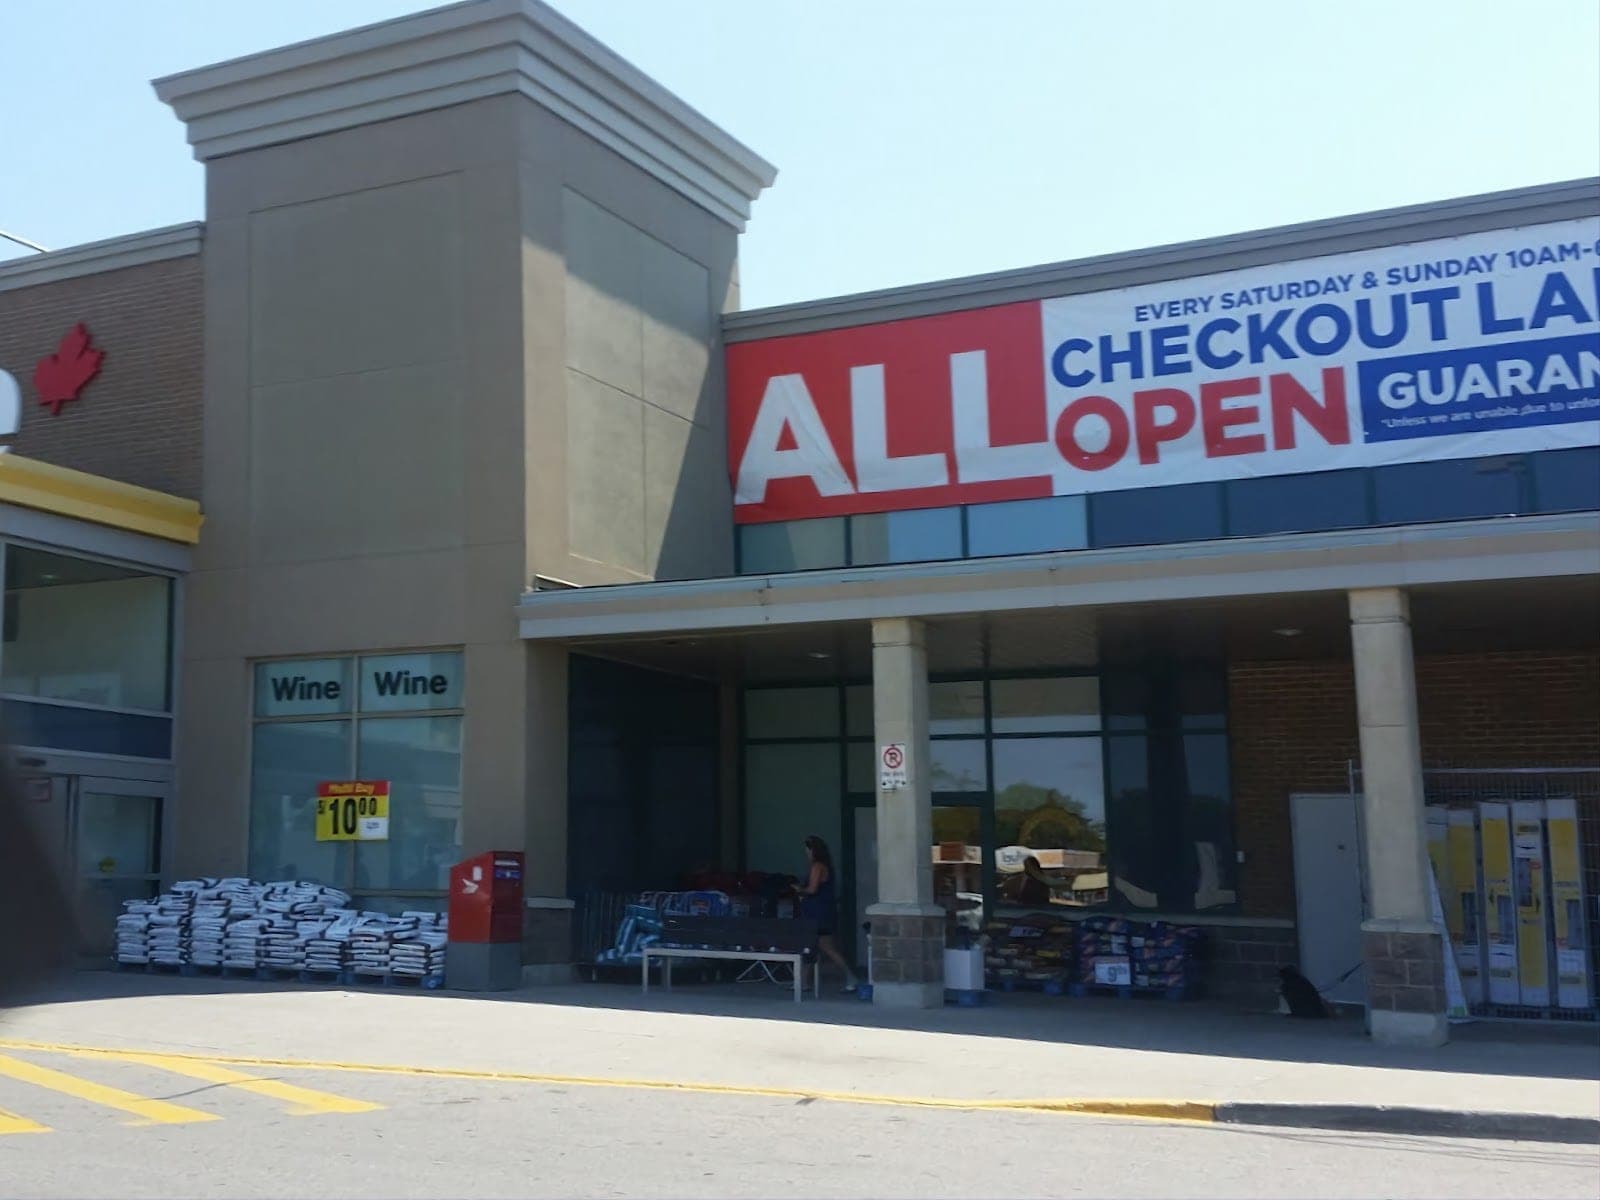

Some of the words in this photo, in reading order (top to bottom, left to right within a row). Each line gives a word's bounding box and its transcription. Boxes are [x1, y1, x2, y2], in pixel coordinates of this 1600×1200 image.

[1051, 286, 1460, 388] CHECKOUT
[1476, 267, 1600, 335] LA
[1134, 295, 1214, 322] EVERY
[1221, 274, 1353, 309] SATURDAY
[1361, 271, 1379, 289] &
[1386, 253, 1498, 285] SUNDAY
[734, 349, 1052, 505] ALL
[1054, 366, 1352, 471] OPEN
[271, 676, 341, 701] Wine
[374, 670, 448, 697] Wine
